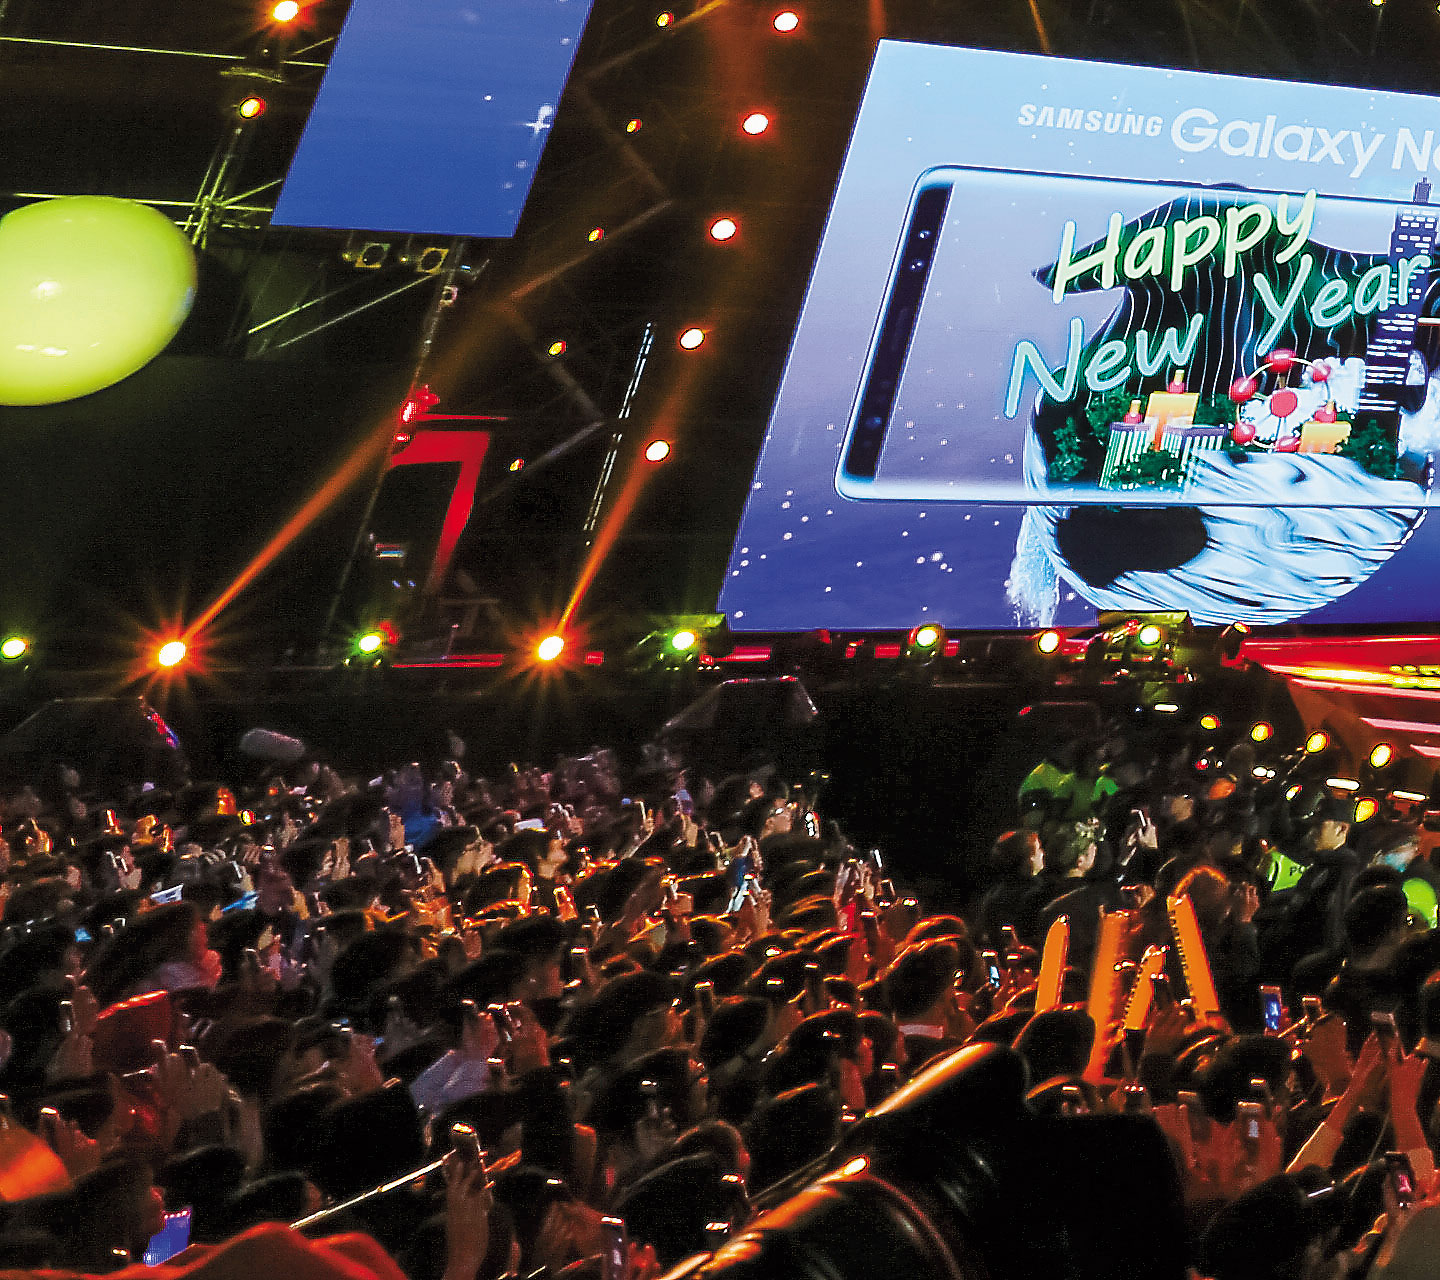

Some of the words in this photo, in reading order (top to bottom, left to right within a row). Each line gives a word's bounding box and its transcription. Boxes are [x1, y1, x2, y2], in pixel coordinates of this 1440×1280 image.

[1017, 101, 1164, 139] SAMSUNG
[1169, 107, 1386, 181] Galaxy
[1049, 188, 1319, 304] Happy
[1005, 310, 1201, 420] New
[1253, 251, 1432, 355] Year
